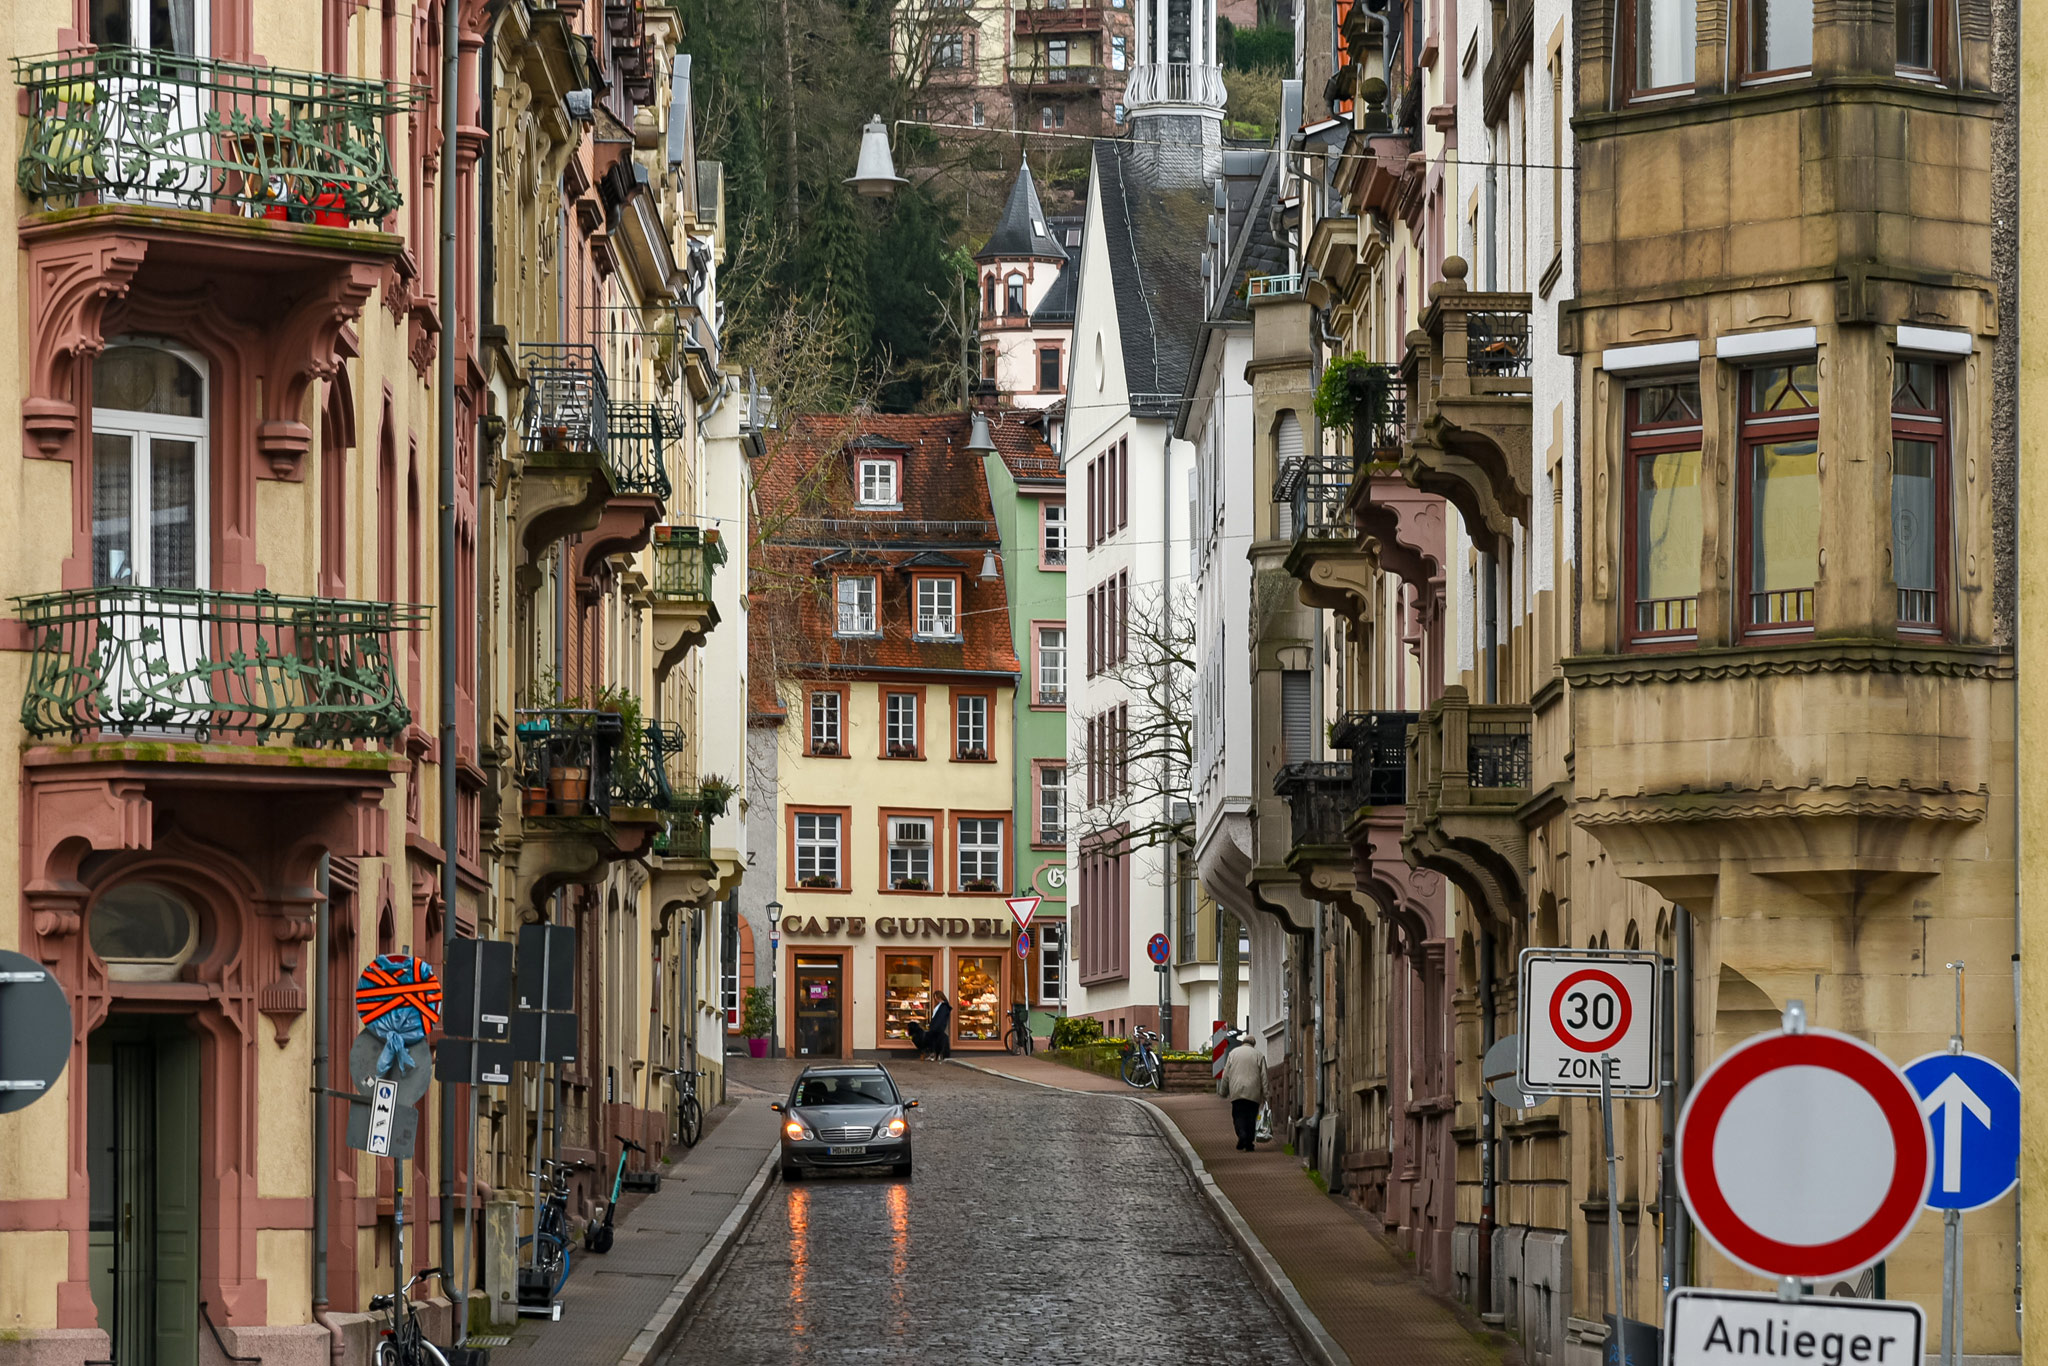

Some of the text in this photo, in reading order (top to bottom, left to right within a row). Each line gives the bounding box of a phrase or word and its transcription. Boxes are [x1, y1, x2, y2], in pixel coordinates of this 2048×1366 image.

[1047, 867, 1067, 888] G
[782, 915, 1010, 938] CAFE GUNDEL
[1566, 992, 1614, 1030] 30
[1558, 1058, 1621, 1079] ZONE
[1703, 1315, 1896, 1366] Anlieger
